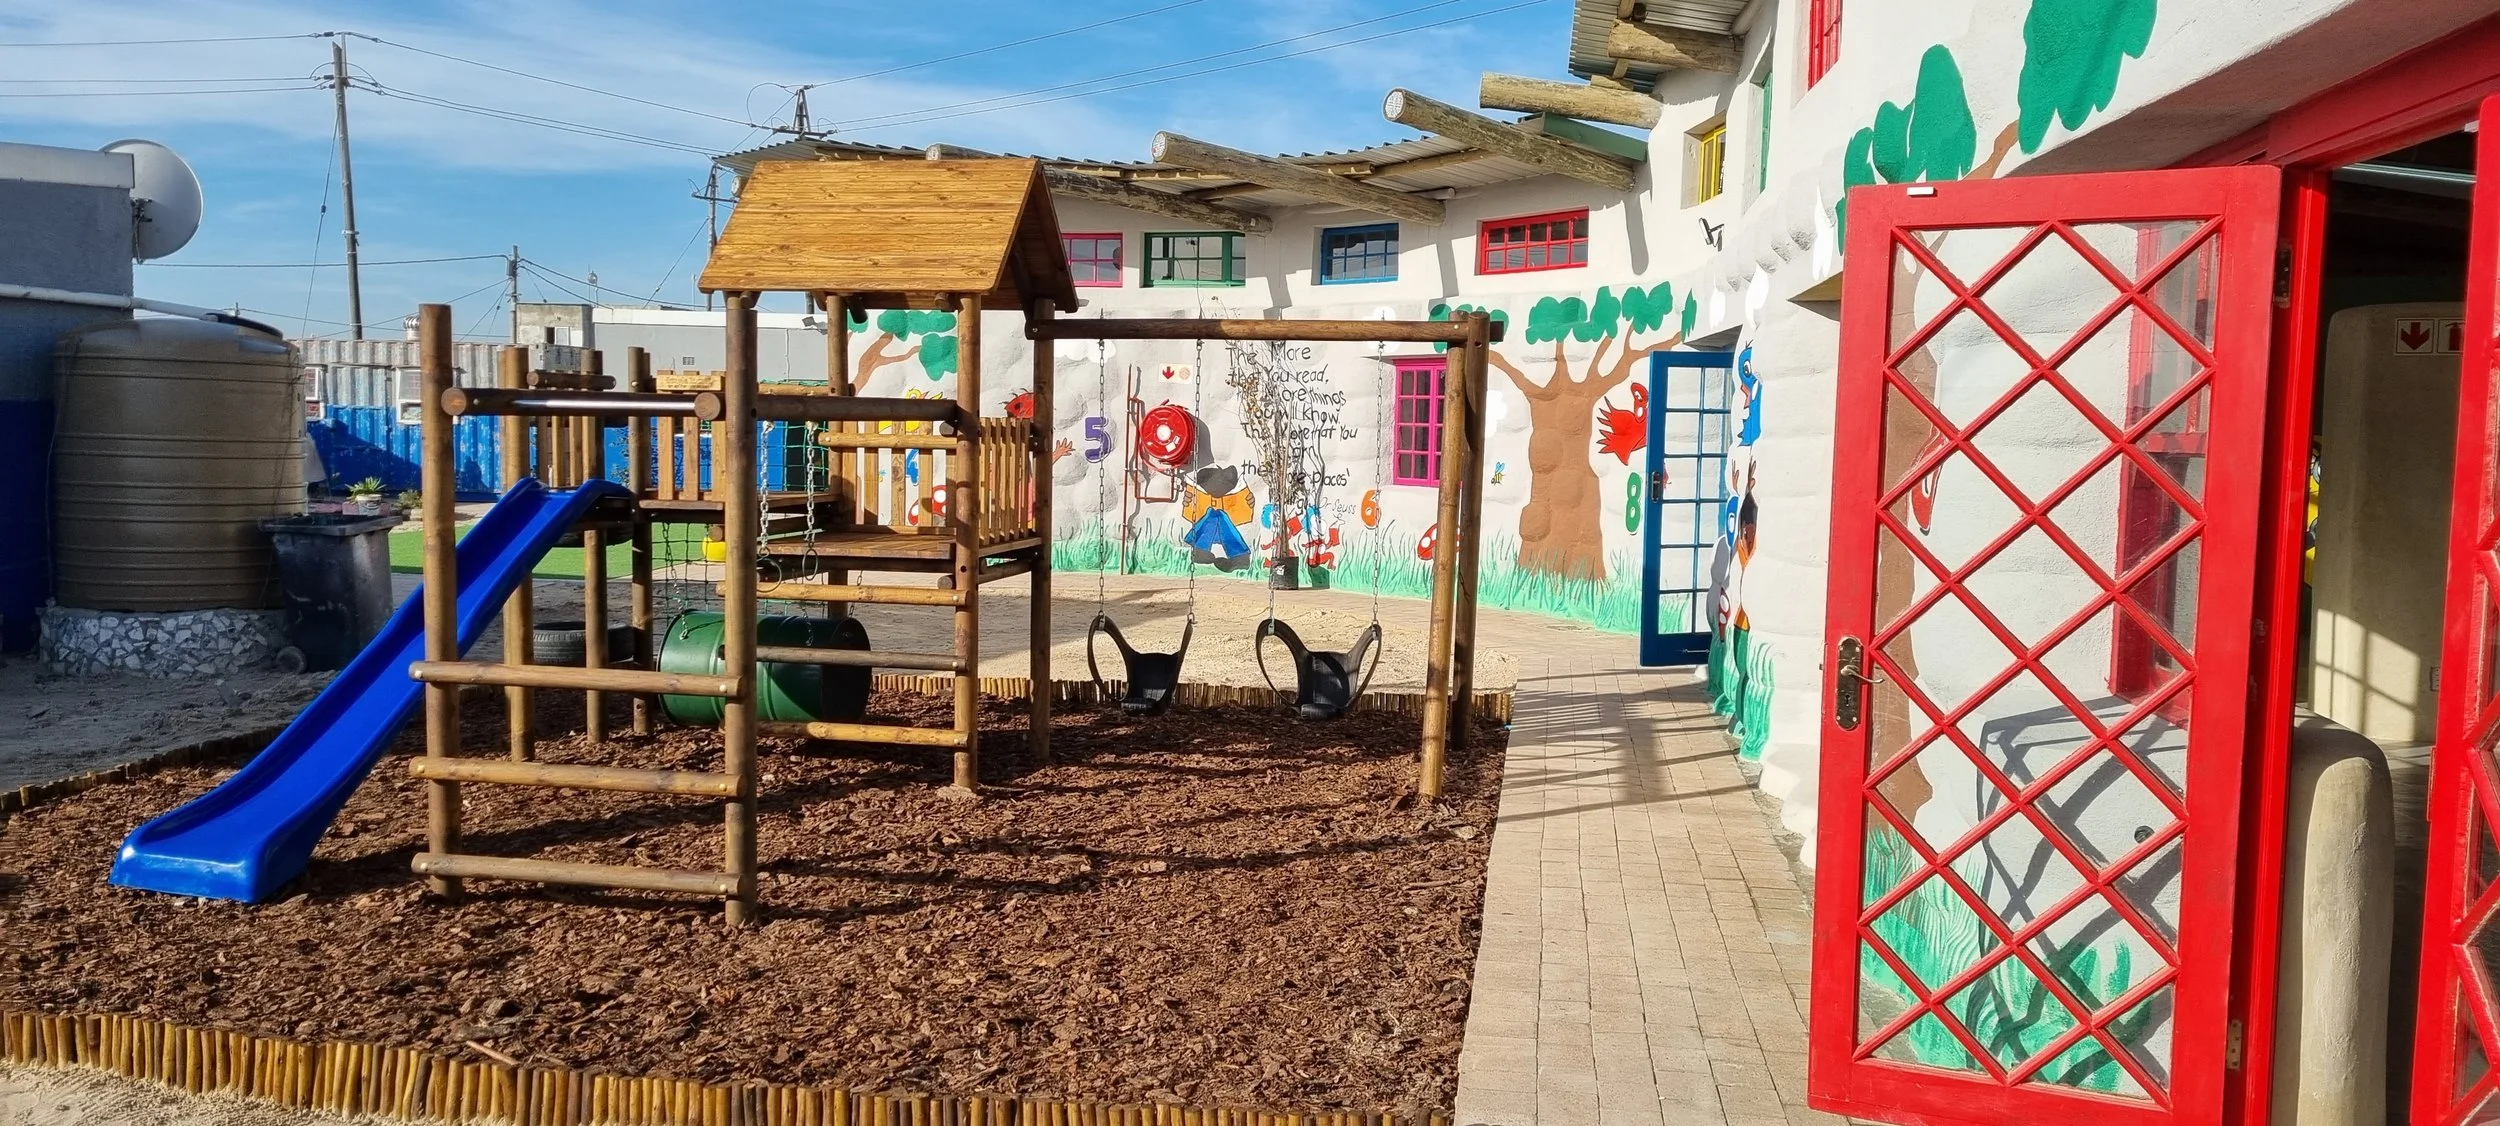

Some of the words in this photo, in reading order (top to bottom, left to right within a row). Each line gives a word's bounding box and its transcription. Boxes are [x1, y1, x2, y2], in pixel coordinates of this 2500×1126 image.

[1271, 340, 1311, 362] More
[1263, 365, 1290, 382] You
[1084, 416, 1112, 463] 5
[1339, 424, 1359, 442] You
[1360, 489, 1382, 530] 6
[1625, 471, 1643, 535] 8
